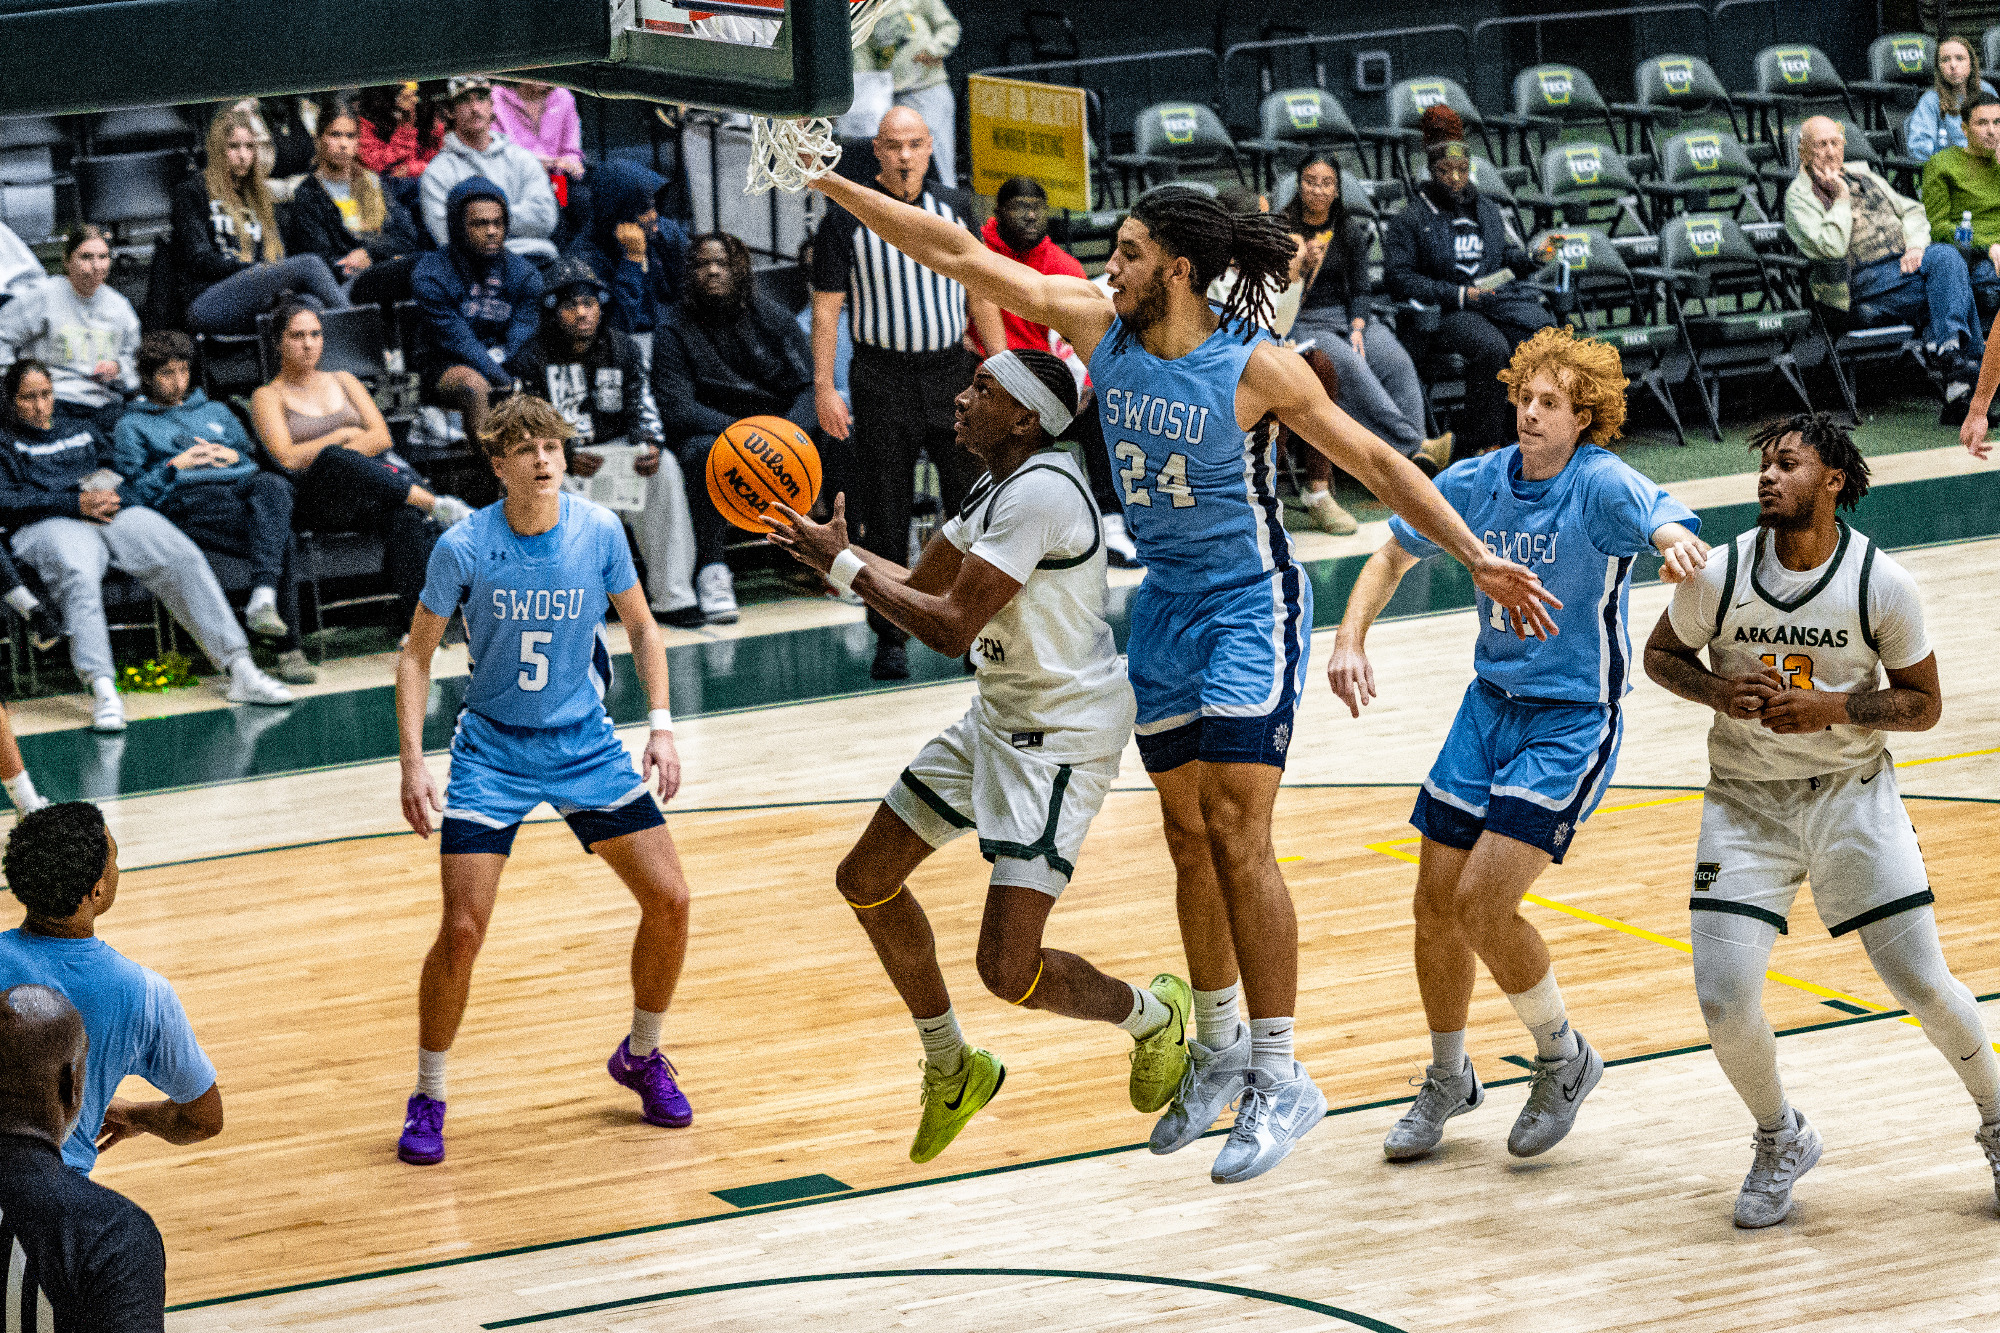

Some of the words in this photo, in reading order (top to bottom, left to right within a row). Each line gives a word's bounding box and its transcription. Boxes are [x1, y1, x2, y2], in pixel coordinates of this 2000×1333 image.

[1894, 49, 1924, 61] TECH
[1779, 60, 1810, 73] TECH
[1662, 70, 1693, 83] TECH
[1689, 145, 1721, 159] TECH
[1568, 159, 1600, 172] TECH
[1689, 230, 1721, 246] TECH
[1106, 387, 1211, 446] SWOSU
[743, 431, 801, 499] Wilson
[1114, 440, 1198, 509] 24
[492, 588, 586, 621] SWOSU
[1734, 624, 1849, 648] ARKANSAS
[518, 630, 554, 693] 5
[1696, 871, 1716, 881] TECH
